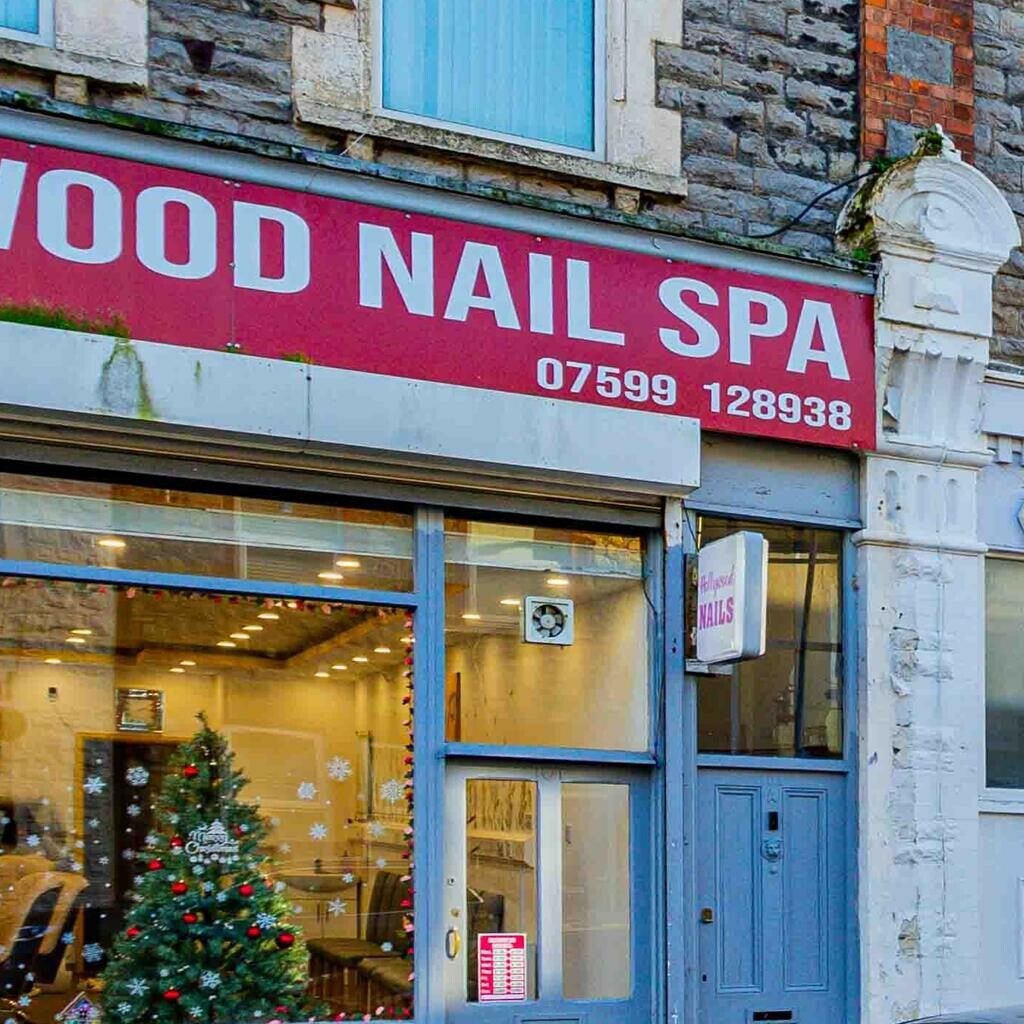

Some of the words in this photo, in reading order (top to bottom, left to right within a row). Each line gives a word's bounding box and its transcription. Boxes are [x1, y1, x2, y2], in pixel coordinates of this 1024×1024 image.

[0, 158, 311, 294] OOD
[358, 222, 625, 346] NAIL
[657, 276, 851, 381] SPA
[536, 357, 677, 406] 07599
[702, 382, 852, 431] 128938
[699, 596, 735, 631] NAILS
